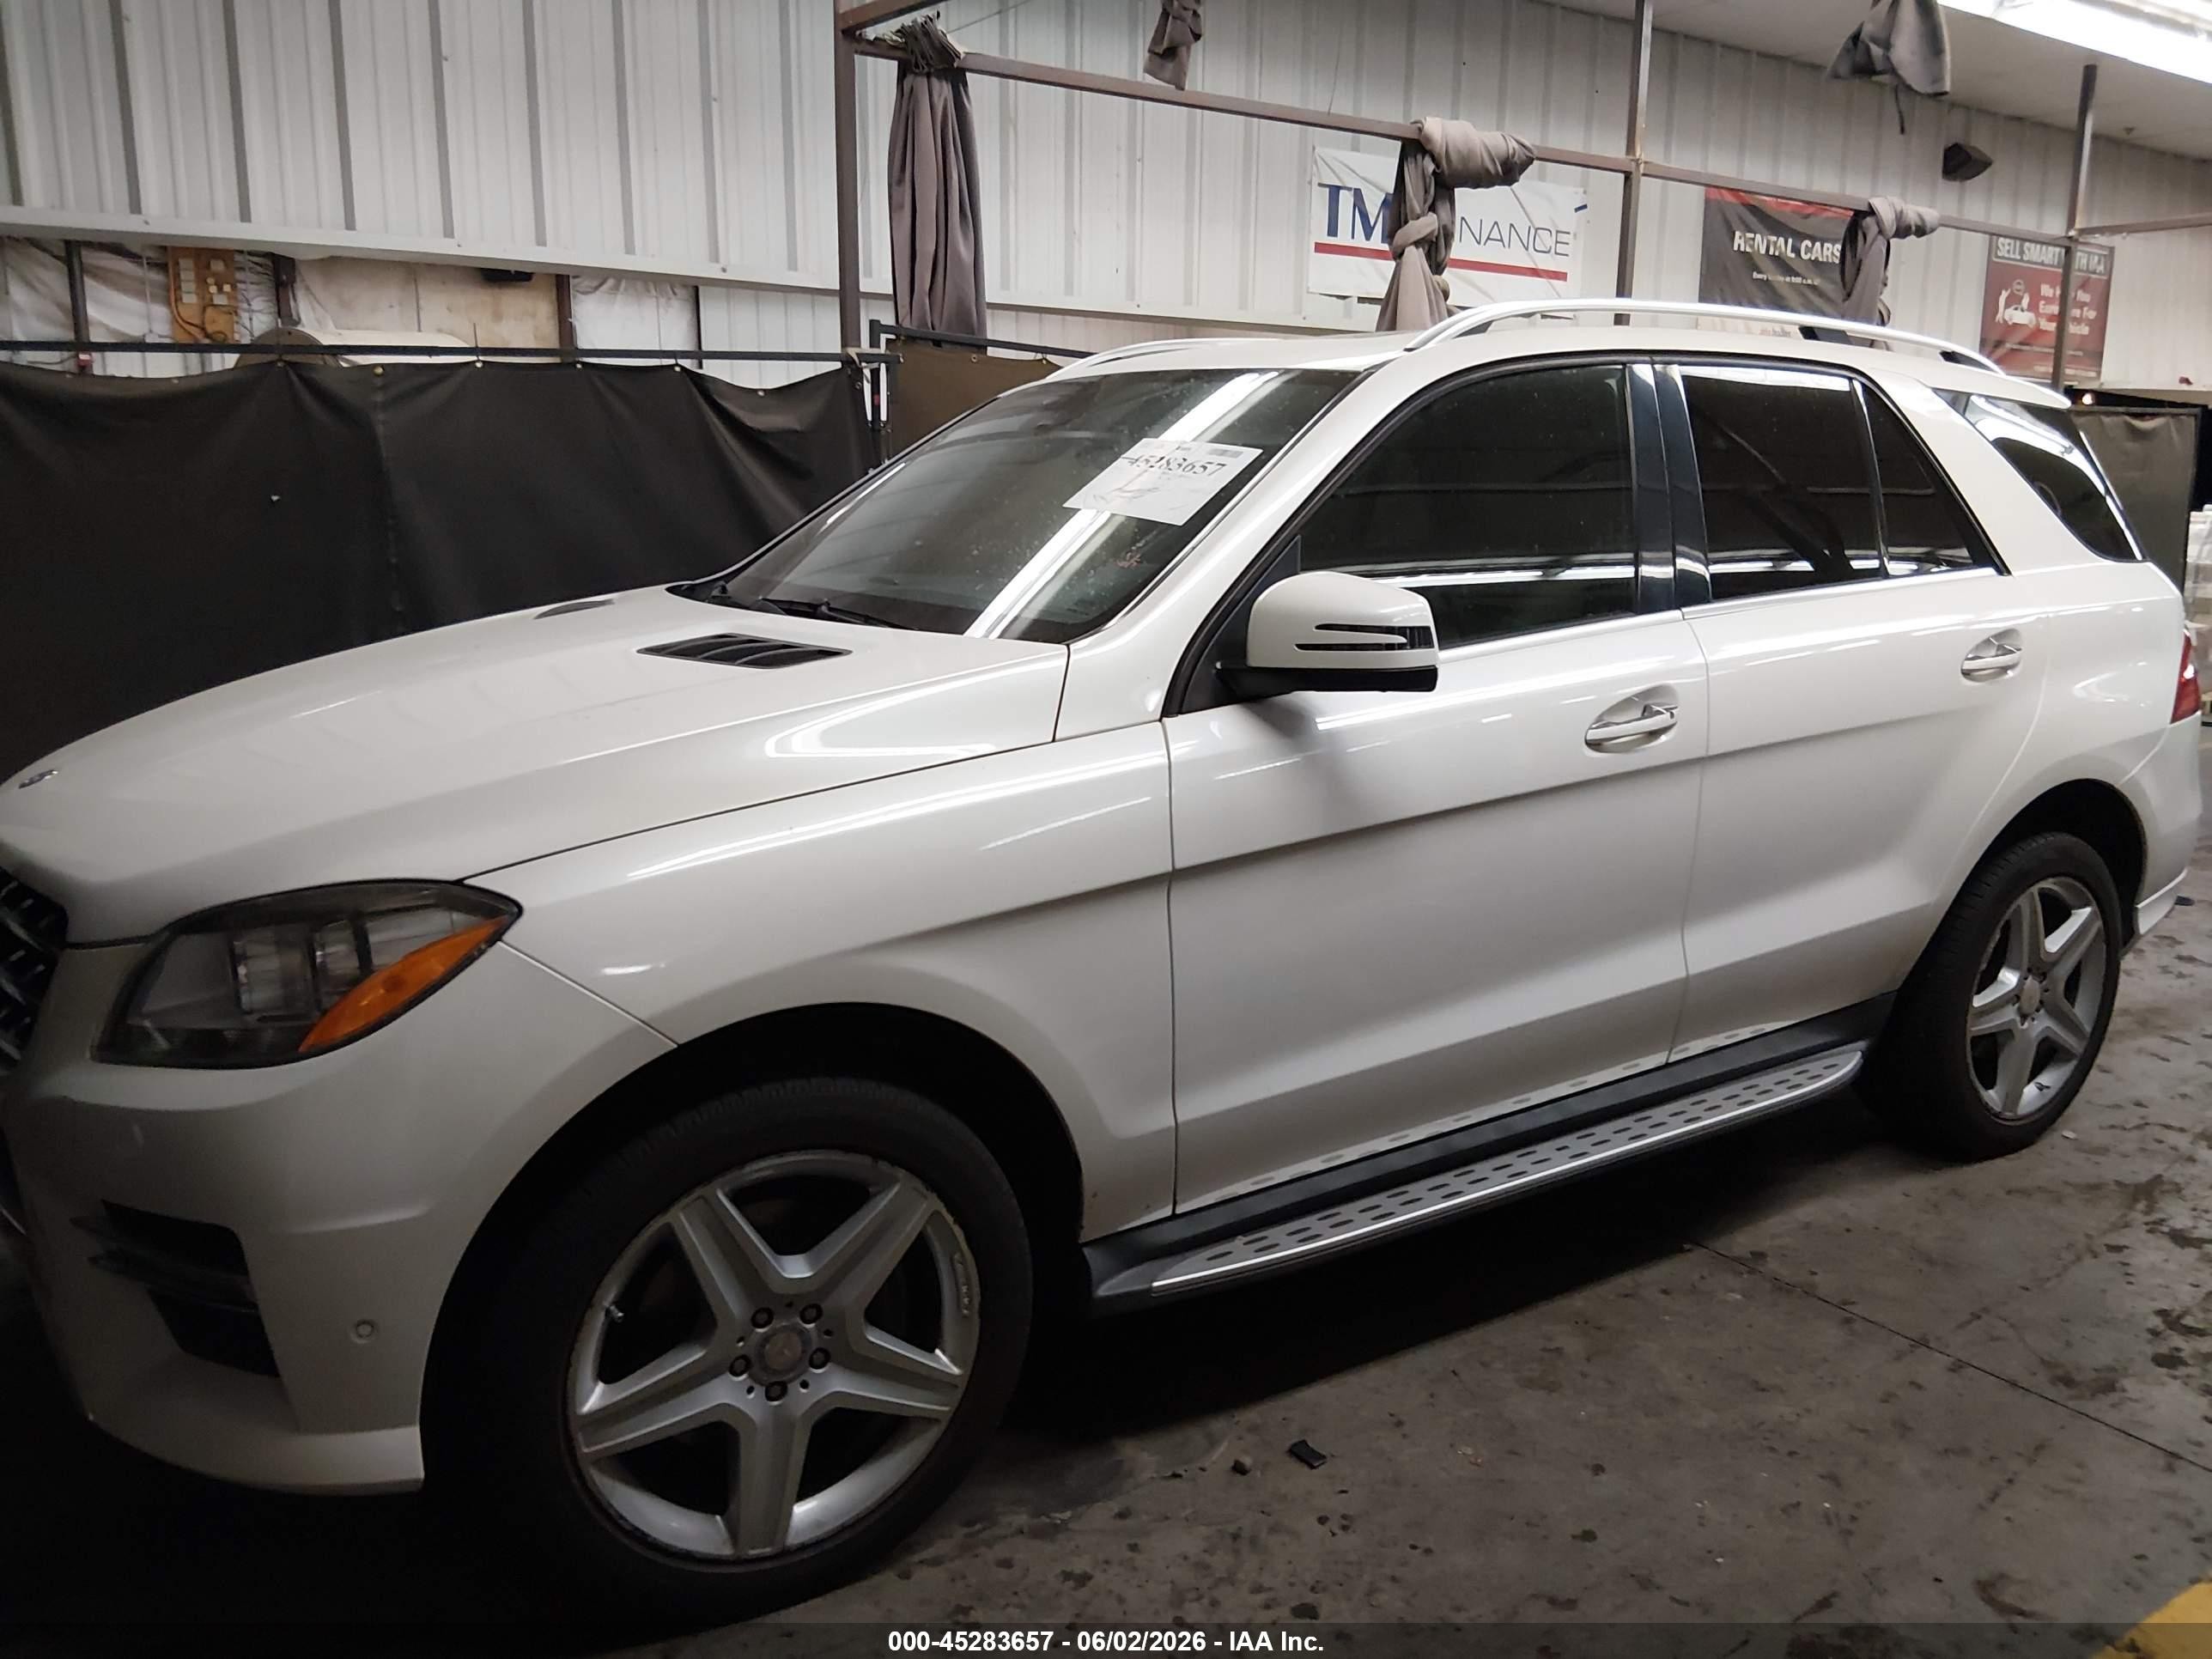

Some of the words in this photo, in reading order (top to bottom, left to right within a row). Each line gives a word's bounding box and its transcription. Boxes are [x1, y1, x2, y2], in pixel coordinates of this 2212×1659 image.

[1317, 183, 1395, 245] TM
[1459, 216, 1571, 257] NANCE
[1733, 230, 1796, 258] RENTAL
[1800, 239, 1842, 264] CARS
[1996, 236, 2021, 259] SELL
[2022, 241, 2059, 266] SMART
